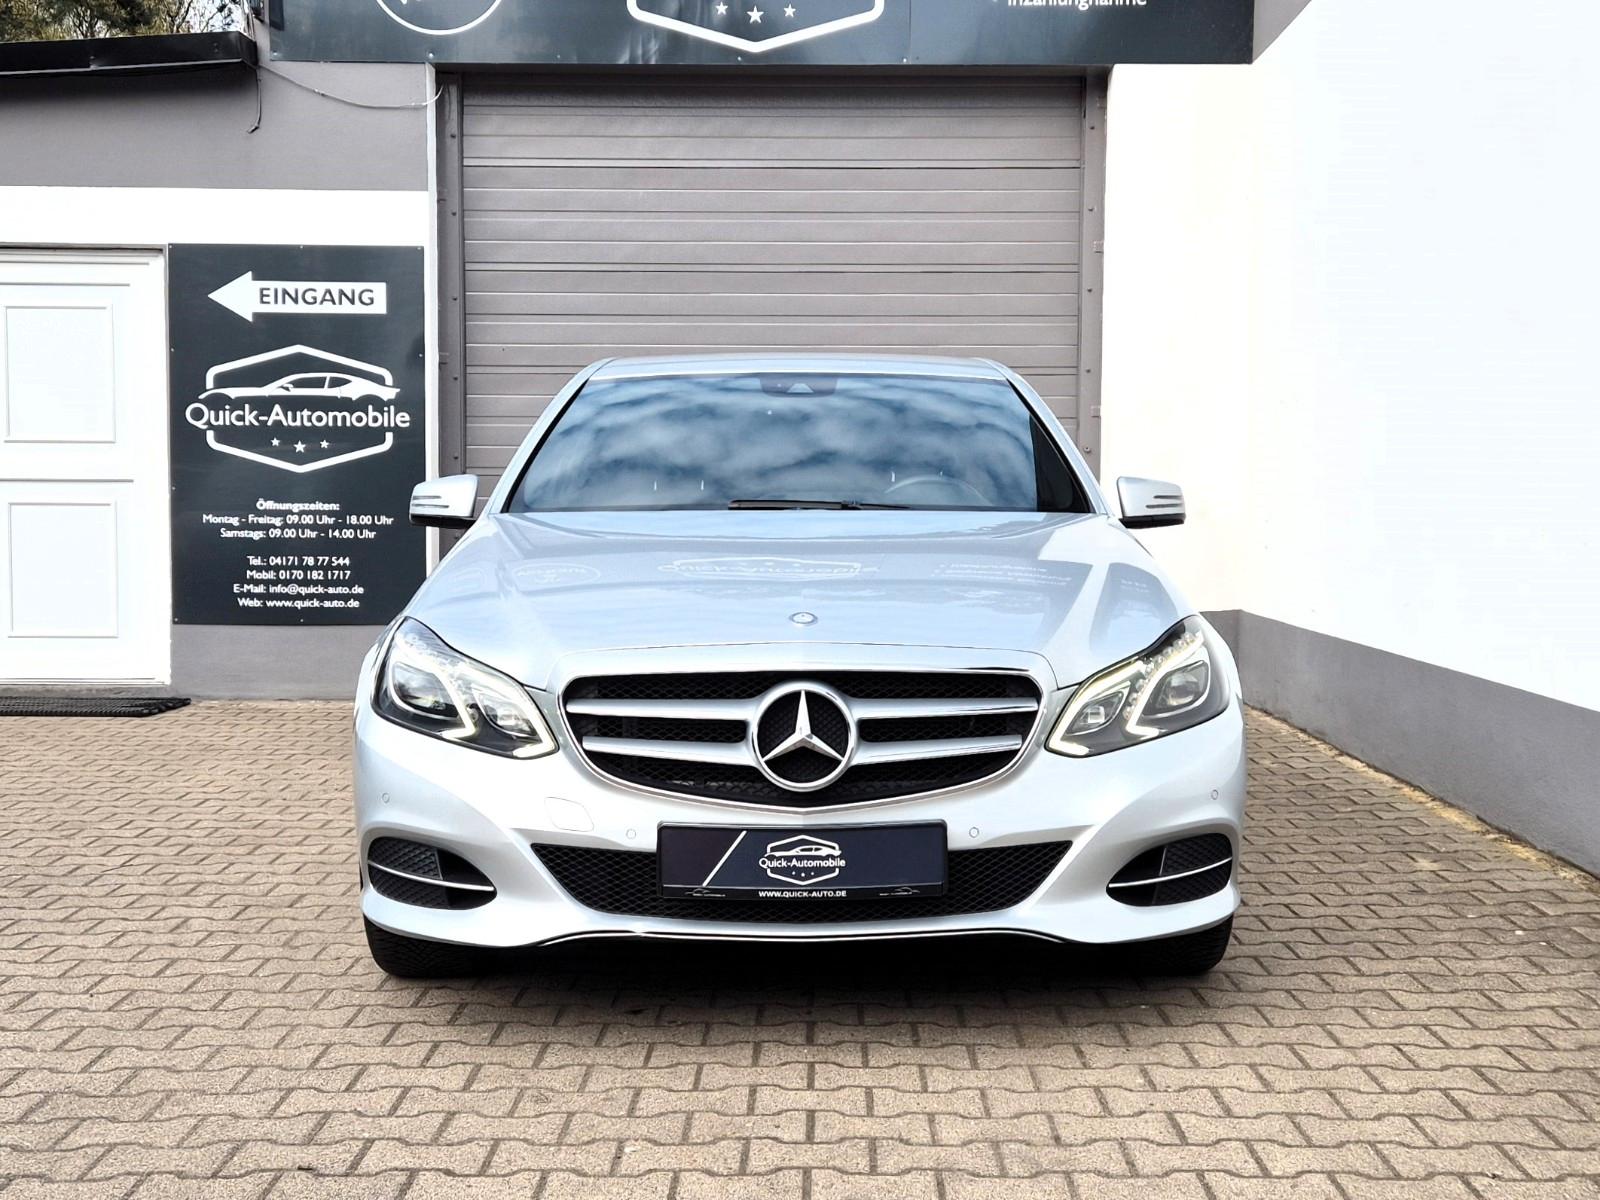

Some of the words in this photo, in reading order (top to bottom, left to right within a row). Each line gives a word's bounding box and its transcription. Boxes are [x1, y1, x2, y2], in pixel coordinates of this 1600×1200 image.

[259, 287, 375, 306] EINGANG
[185, 403, 411, 429] Quick-Automobile
[256, 498, 340, 512] Öffnungszeiten:
[203, 514, 239, 525] Montag
[248, 514, 284, 526] Freitag:
[286, 514, 314, 525] 09.00
[316, 515, 336, 525] Uhr
[346, 515, 372, 525] 18.00
[374, 515, 394, 525] Uhr
[220, 528, 266, 540] Samstags:
[269, 527, 297, 538] 09.00
[299, 528, 318, 538] Uhr
[328, 529, 354, 539] 14.00
[357, 529, 376, 539] Uhr
[247, 556, 266, 566] Tel.:
[269, 556, 298, 566] 04171
[302, 556, 314, 566] 78
[317, 556, 329, 566] 77
[332, 557, 350, 566] 544
[247, 570, 276, 580] Mobil:
[279, 570, 304, 580] 0170
[307, 570, 324, 580] 182
[328, 570, 351, 580] 1717
[233, 584, 266, 593] E-Mail:
[269, 584, 364, 596] info@quick-auto.de
[237, 598, 263, 607] Web:
[266, 598, 360, 610] www.quick-auto.de
[759, 856, 846, 869] Quick-Automobile
[758, 890, 847, 898] WWW.QUICK-AUTO.DE
